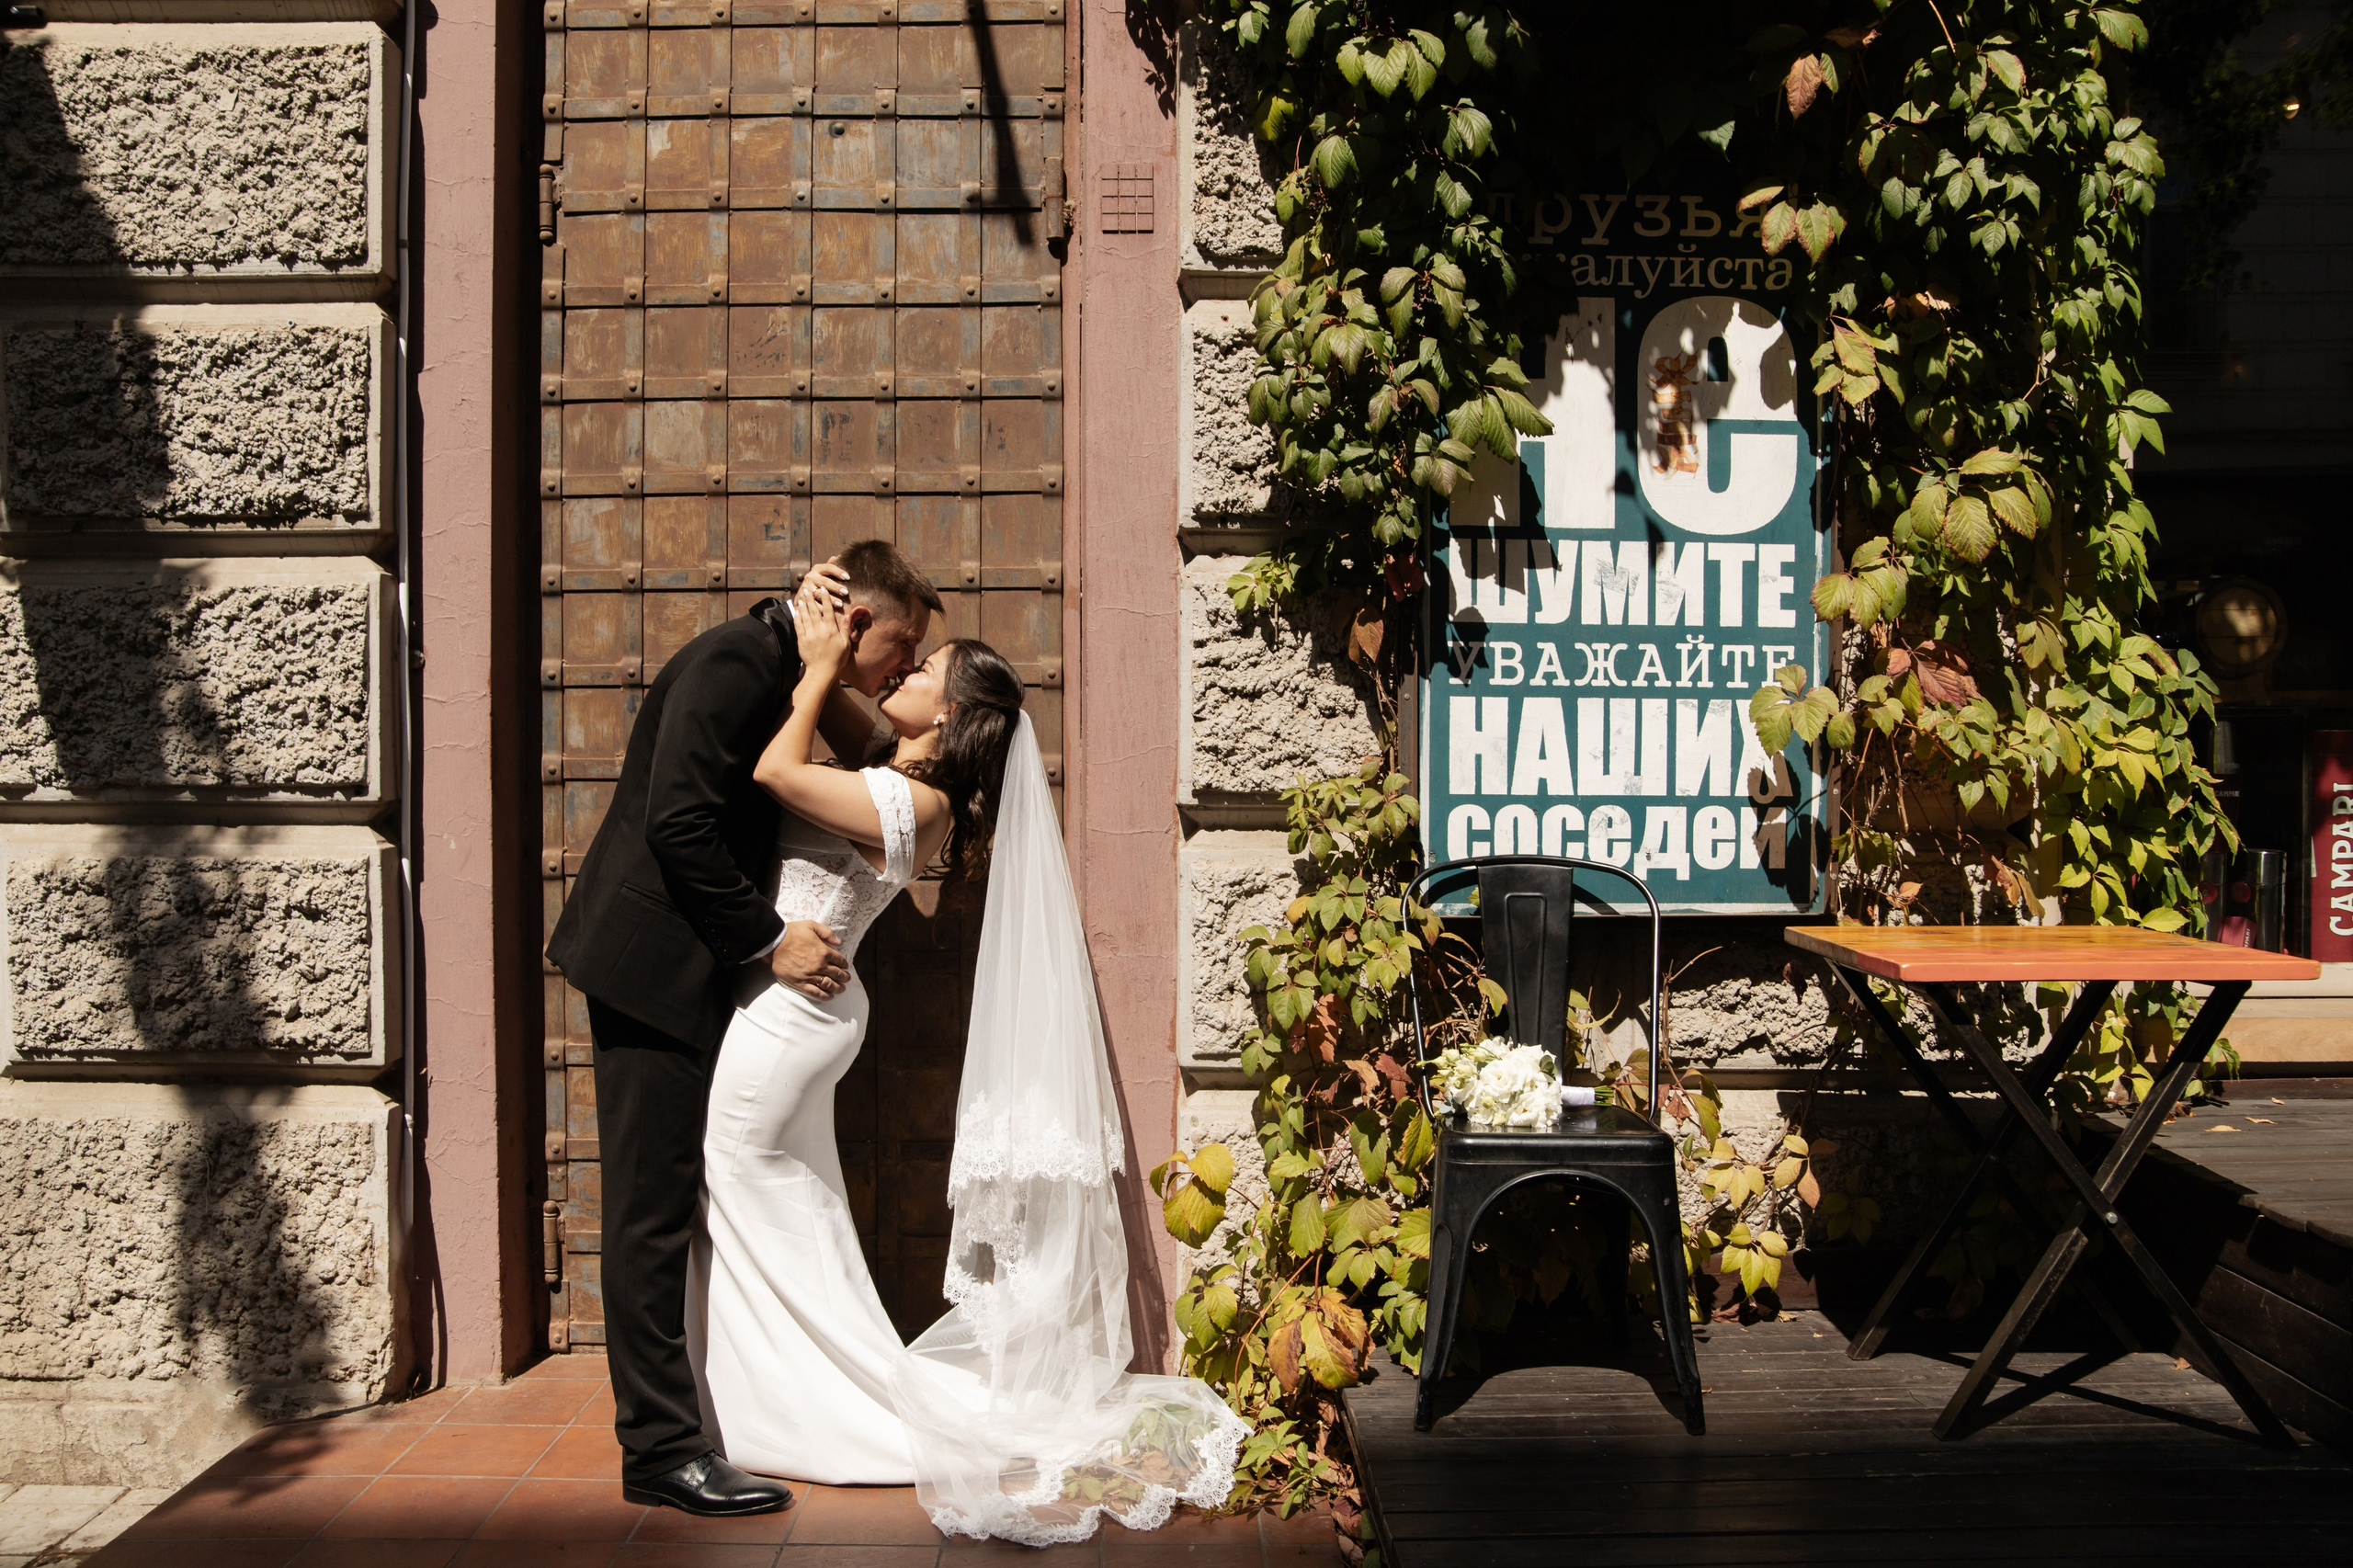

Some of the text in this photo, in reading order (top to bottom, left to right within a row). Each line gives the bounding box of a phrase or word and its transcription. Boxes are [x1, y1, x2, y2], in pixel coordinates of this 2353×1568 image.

[1510, 243, 1793, 300] алуйста
[1449, 539, 1796, 628] ШУМИТЕ
[1447, 634, 1795, 688] УВАЖАЙТЕ
[1449, 696, 1792, 797] НАШИХ
